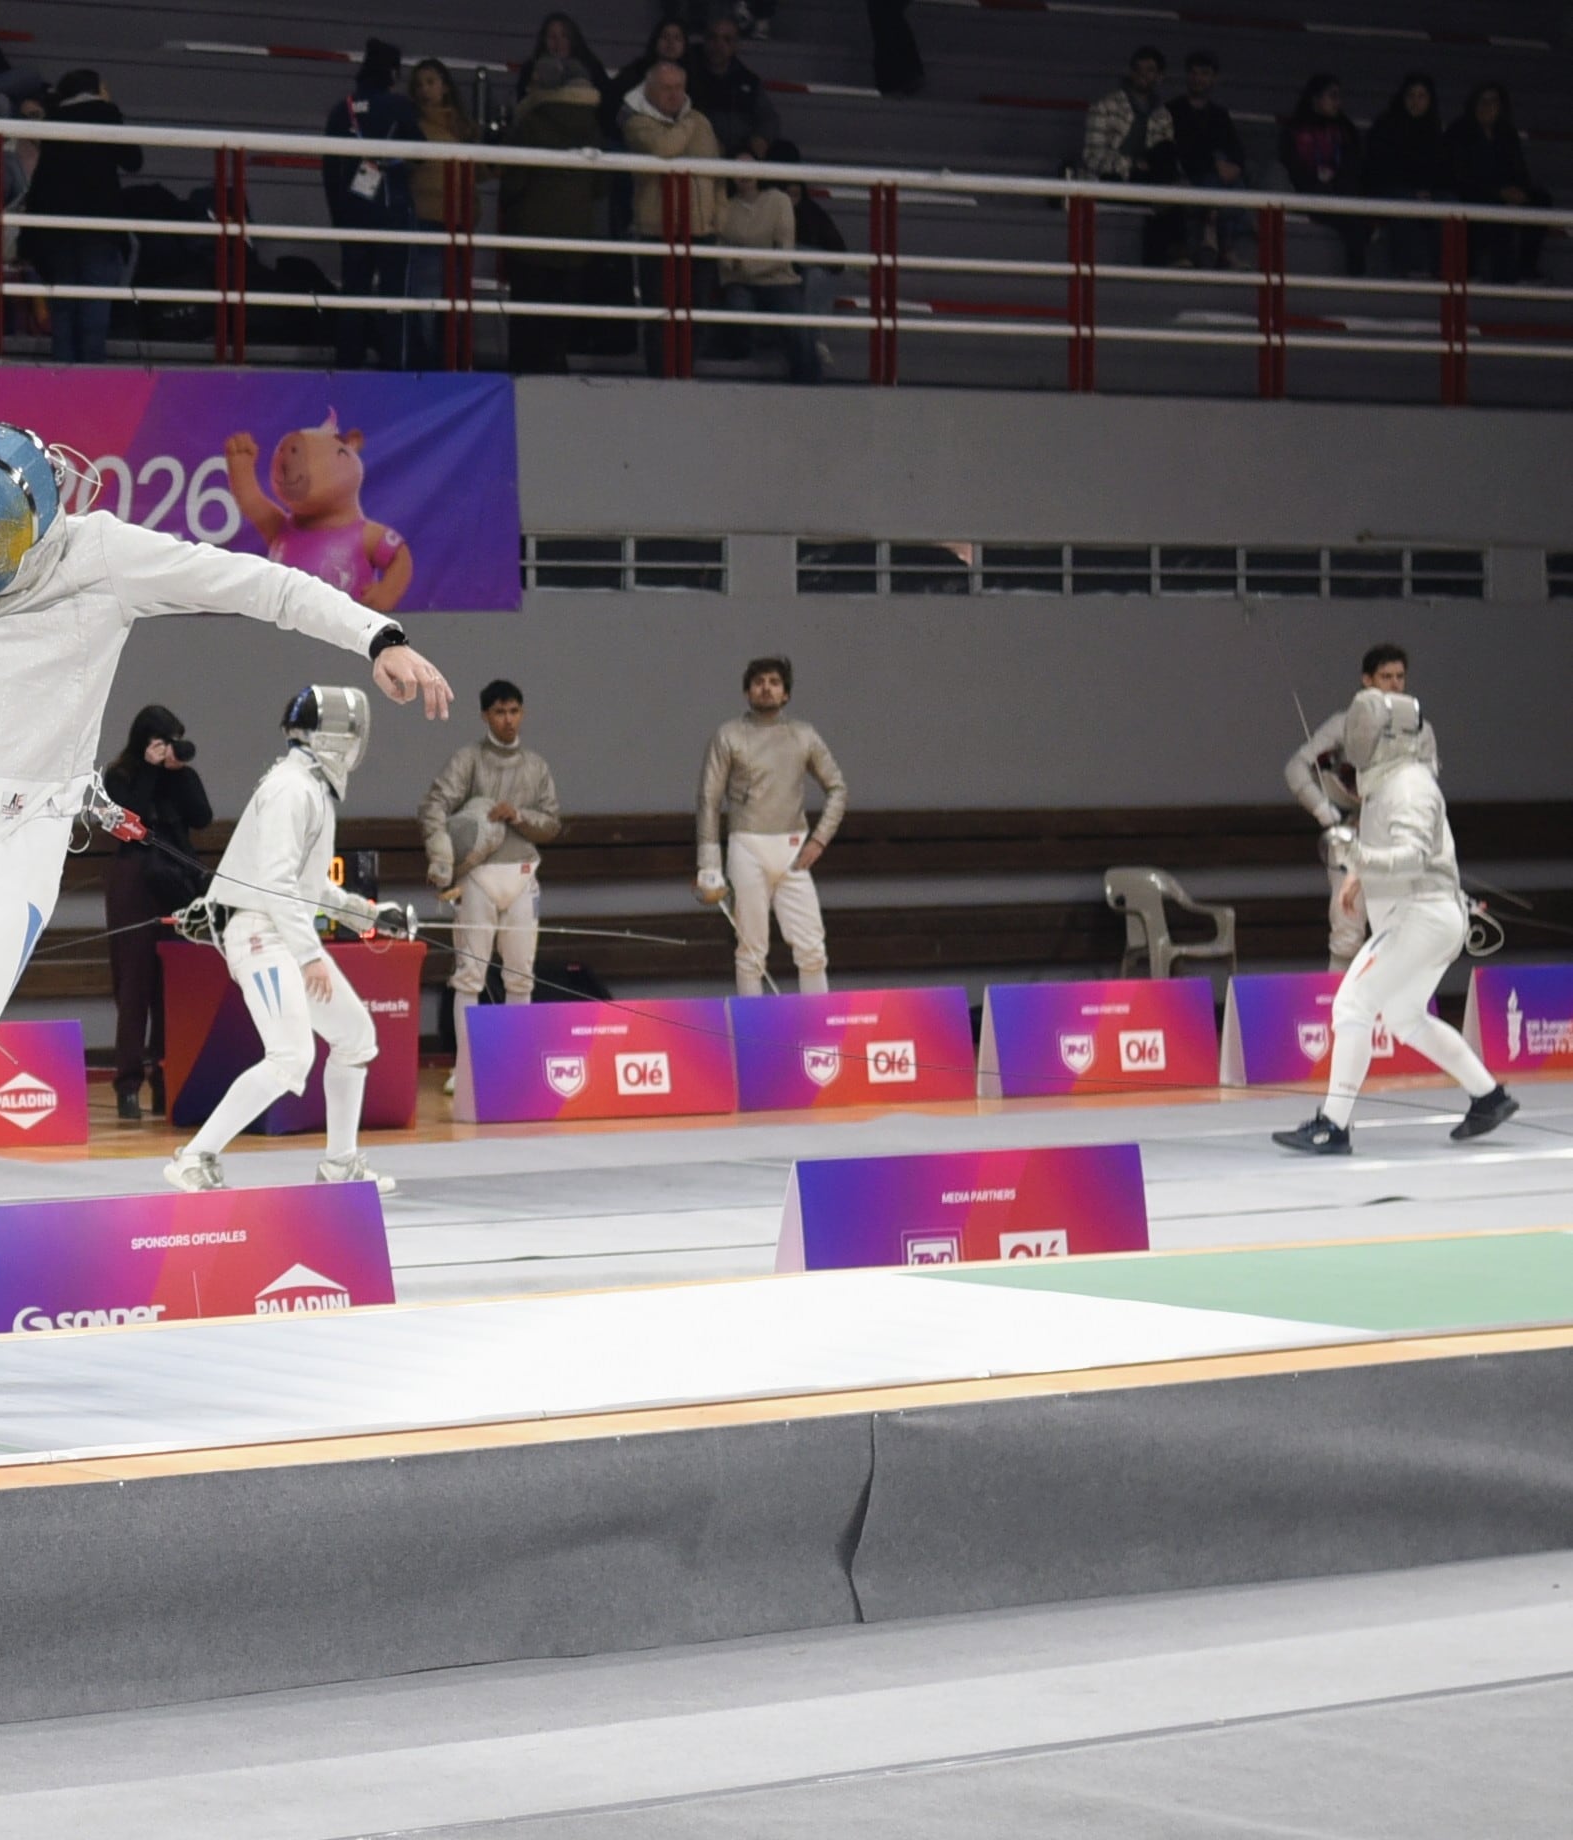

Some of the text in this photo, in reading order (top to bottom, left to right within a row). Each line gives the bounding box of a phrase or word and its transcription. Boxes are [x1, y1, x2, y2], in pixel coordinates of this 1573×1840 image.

[874, 1049, 909, 1074] Olé
[1126, 1037, 1159, 1063] Olé
[623, 1061, 663, 1086] Olé
[941, 1188, 1016, 1204] MEDIA PARTNERS
[131, 1230, 247, 1250] SPONSORS OFICIALES
